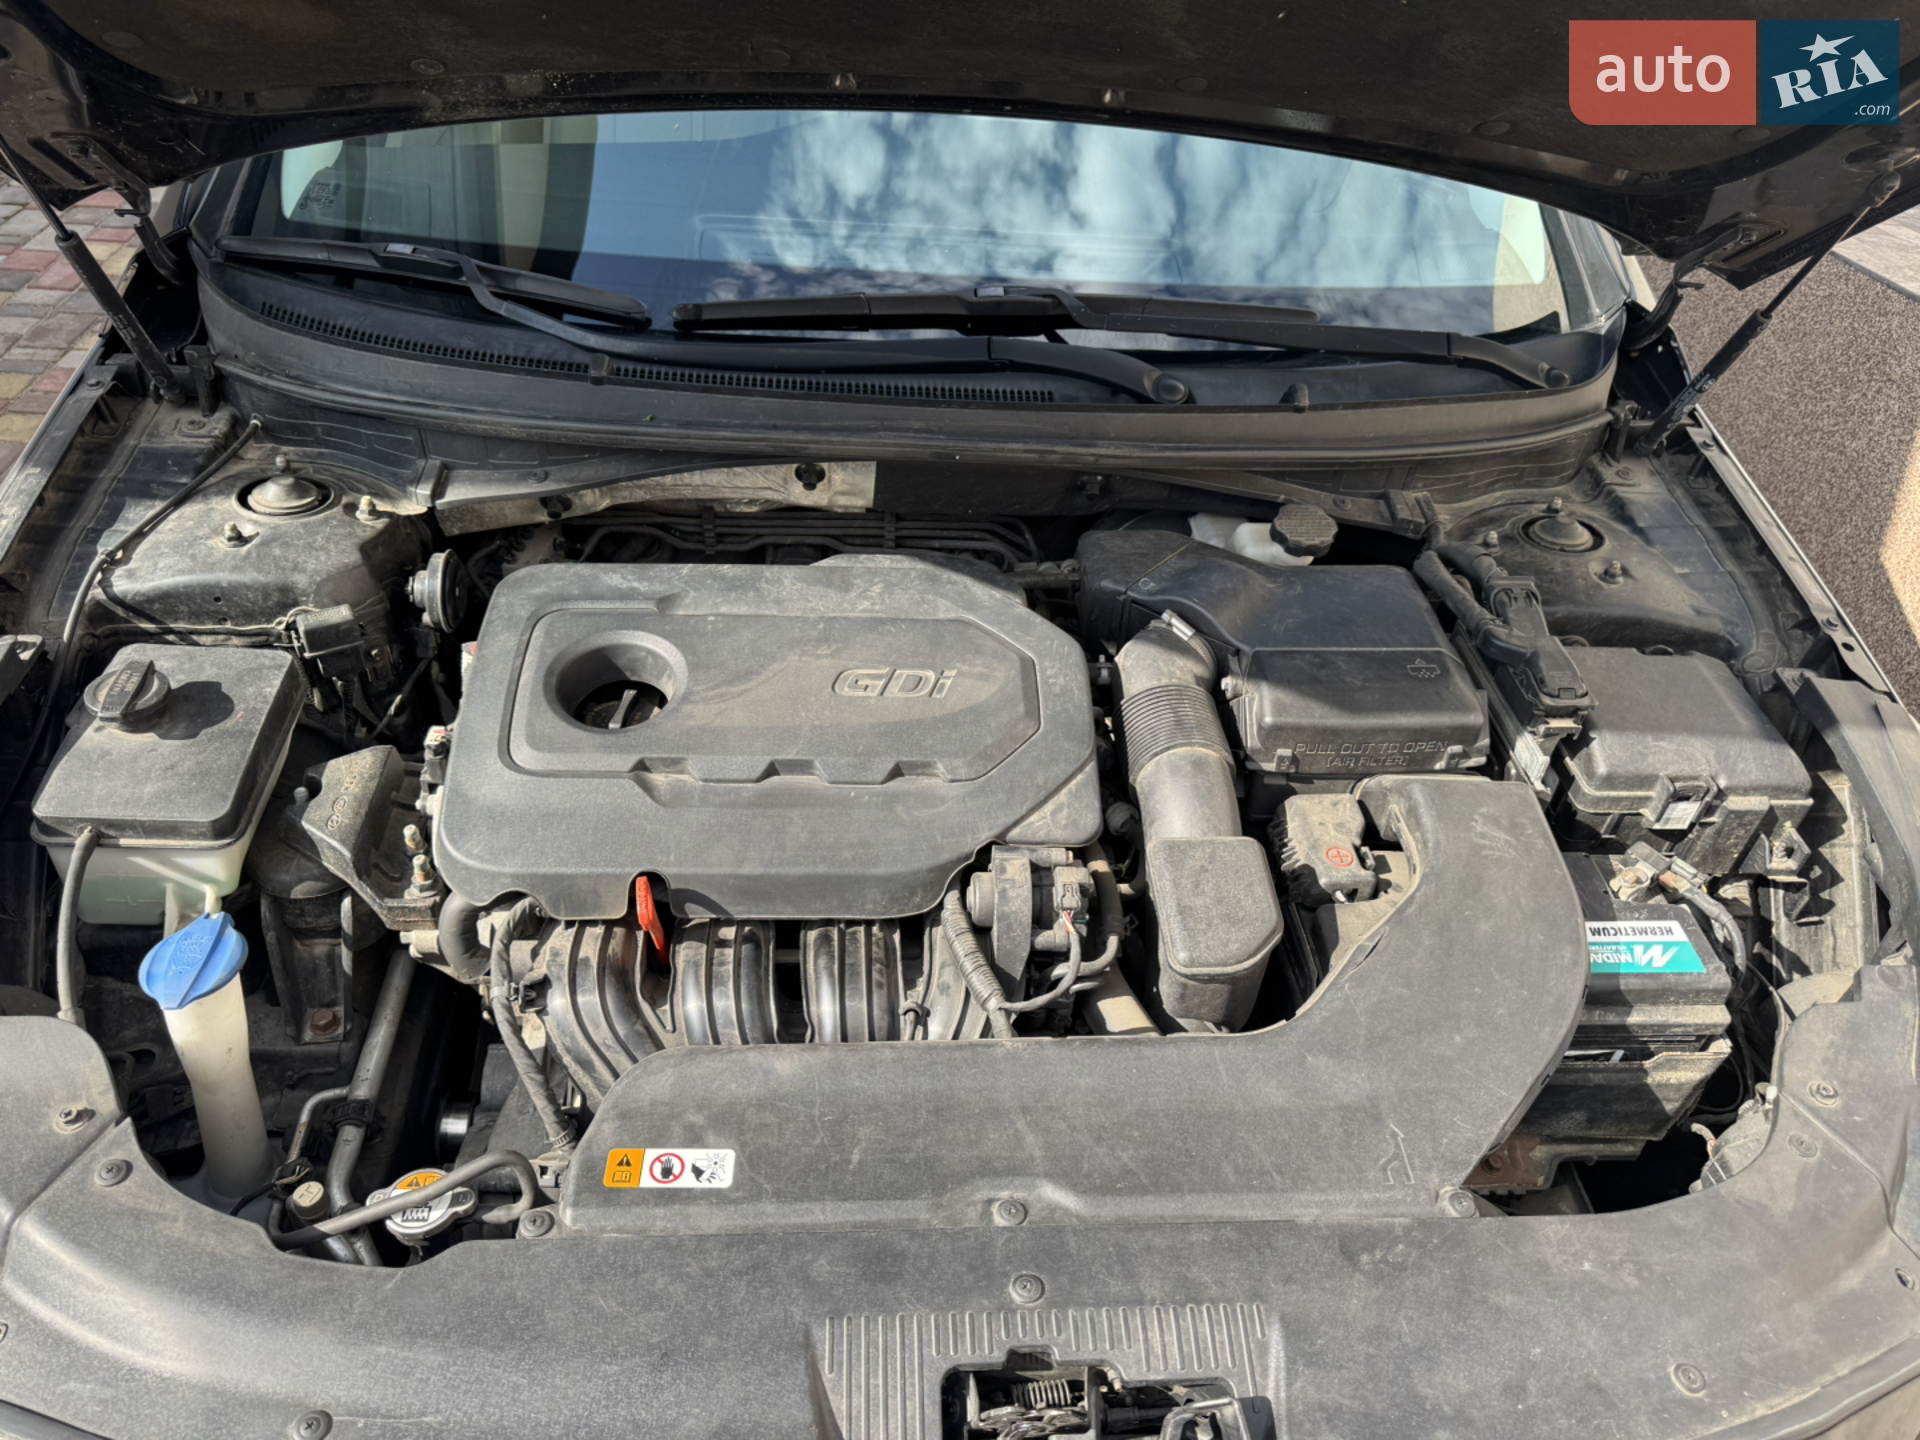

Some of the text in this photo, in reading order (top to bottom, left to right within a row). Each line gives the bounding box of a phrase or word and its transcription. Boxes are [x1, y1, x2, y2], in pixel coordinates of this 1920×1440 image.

[1294, 741, 1449, 755] PULL OUT TO OPEN
[1589, 926, 1674, 936] HERMETICUM
[1590, 952, 1634, 964] MIDA
